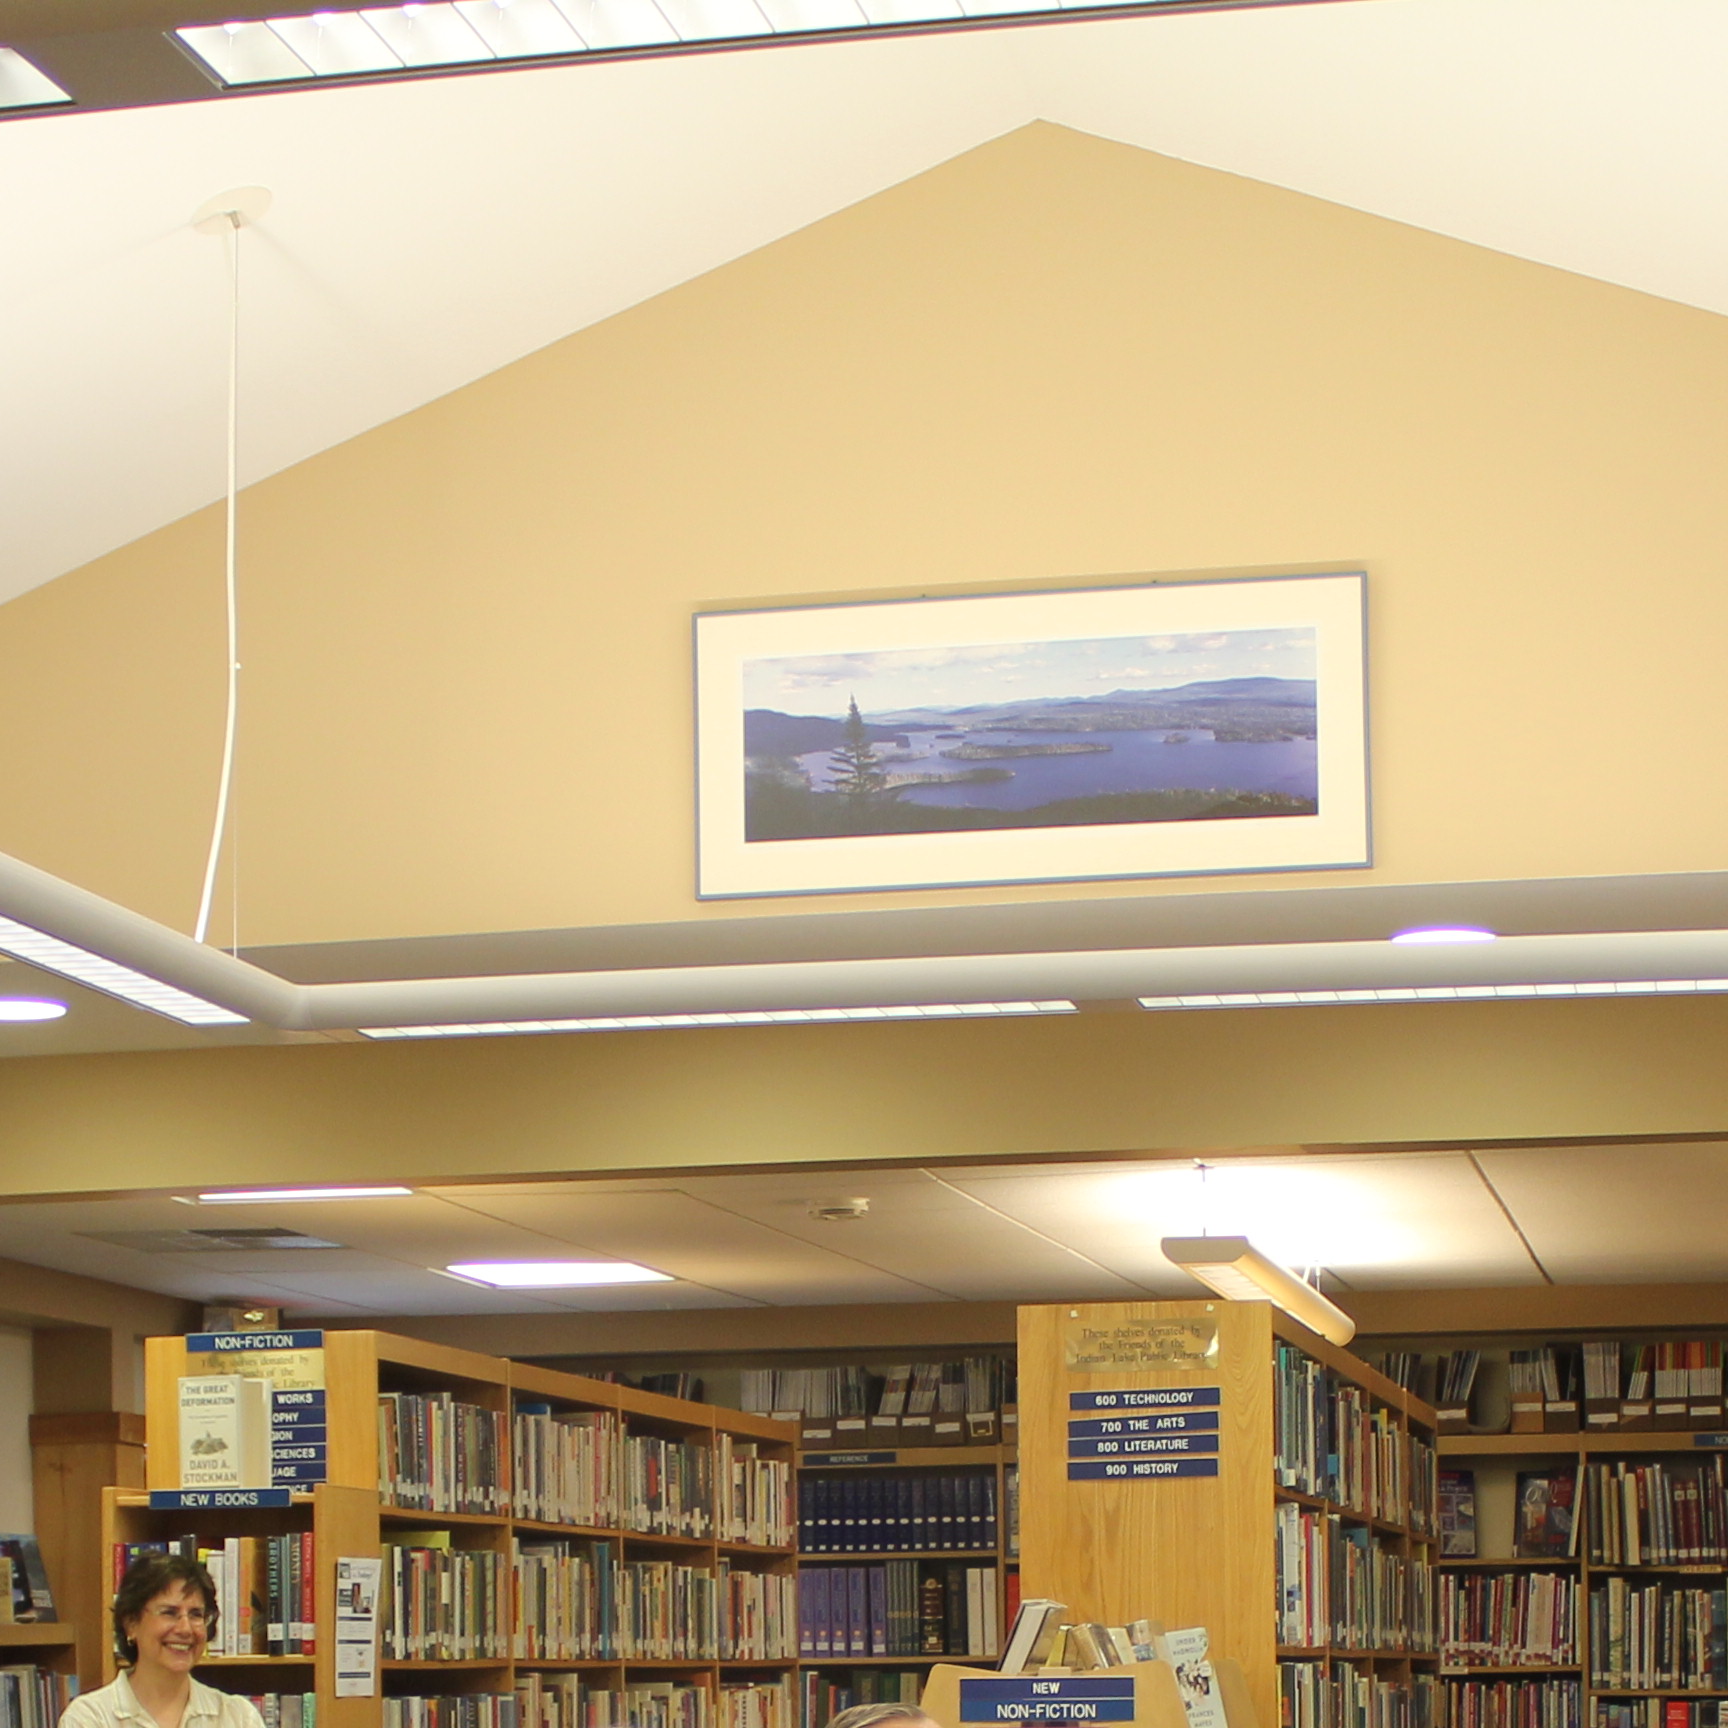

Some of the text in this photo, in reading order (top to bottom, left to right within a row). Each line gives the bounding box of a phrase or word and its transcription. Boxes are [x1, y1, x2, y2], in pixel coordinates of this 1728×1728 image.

[215, 1335, 293, 1349] NON-FICTION
[186, 1385, 228, 1394] THE GREAT
[181, 1397, 235, 1407] DEFORMATION
[277, 1393, 313, 1404] WORKS
[1095, 1392, 1193, 1405] 600 TECHNOLOGY
[1101, 1417, 1185, 1433] 700 THE ARTS
[1097, 1439, 1189, 1453] 800 LITERATURE
[189, 1460, 230, 1470] DAVID A.
[829, 1455, 869, 1463] REFERENCE
[1106, 1463, 1179, 1475] 900 HISTORY
[183, 1472, 237, 1483] STOCKMAN
[180, 1493, 258, 1506] NEW BOOKS
[1033, 1682, 1060, 1694] NEW
[997, 1704, 1096, 1718] NON-FICTION
